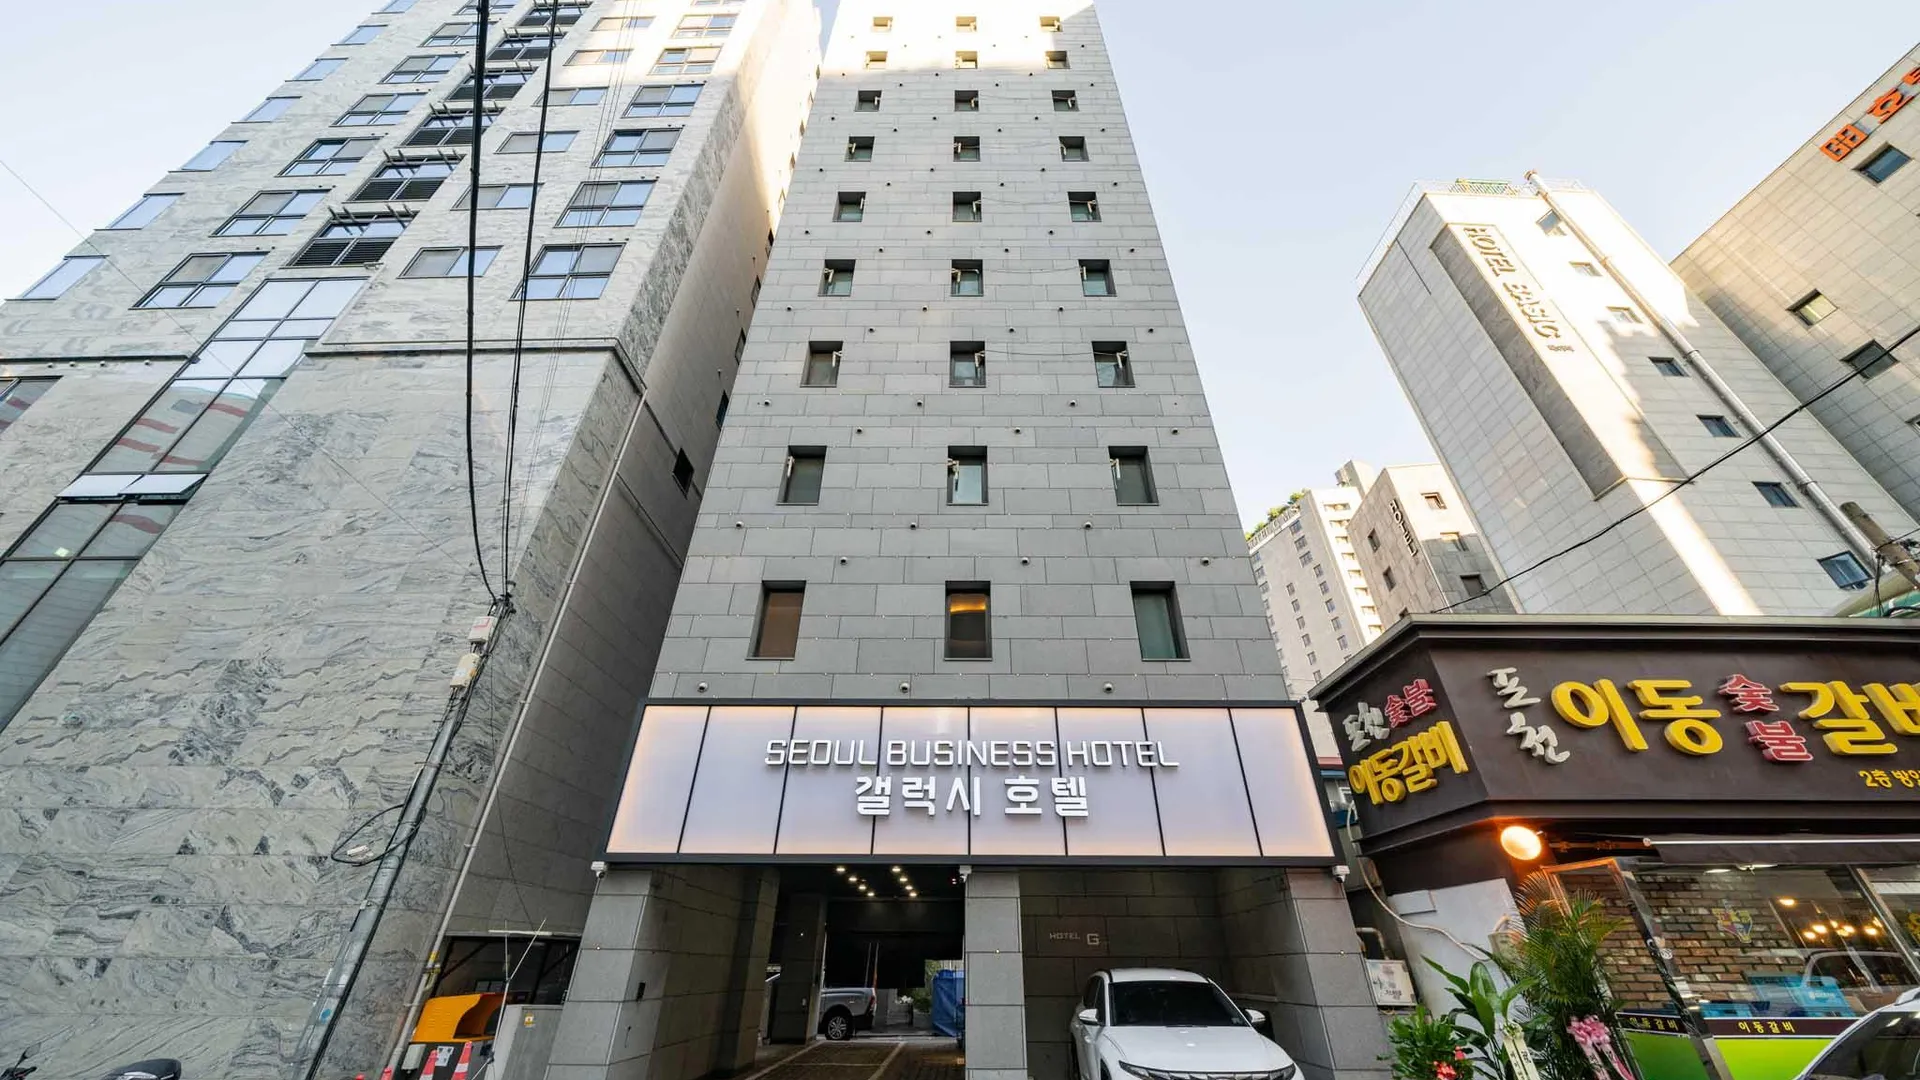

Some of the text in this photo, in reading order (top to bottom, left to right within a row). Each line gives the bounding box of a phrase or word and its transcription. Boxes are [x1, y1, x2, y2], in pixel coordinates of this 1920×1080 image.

[1463, 227, 1517, 277] HOTEL
[1503, 282, 1561, 339] BASIC
[1389, 499, 1419, 558] HOTEL
[1384, 678, 1438, 729] 숯불
[1484, 667, 1571, 764] 포천
[1551, 678, 1724, 756] 이동
[1717, 673, 1813, 762] 숯불
[764, 739, 1180, 768] SEOUL BUSINESS HOTEL
[1348, 720, 1469, 805] 이동갈비
[854, 774, 1090, 817] 갤럭시 호텔
[1858, 768, 1892, 788] 2층
[1049, 932, 1101, 946] HOTEL G
[1629, 1016, 1680, 1031] 이동갈비
[1737, 1020, 1796, 1034] 이동갈비
